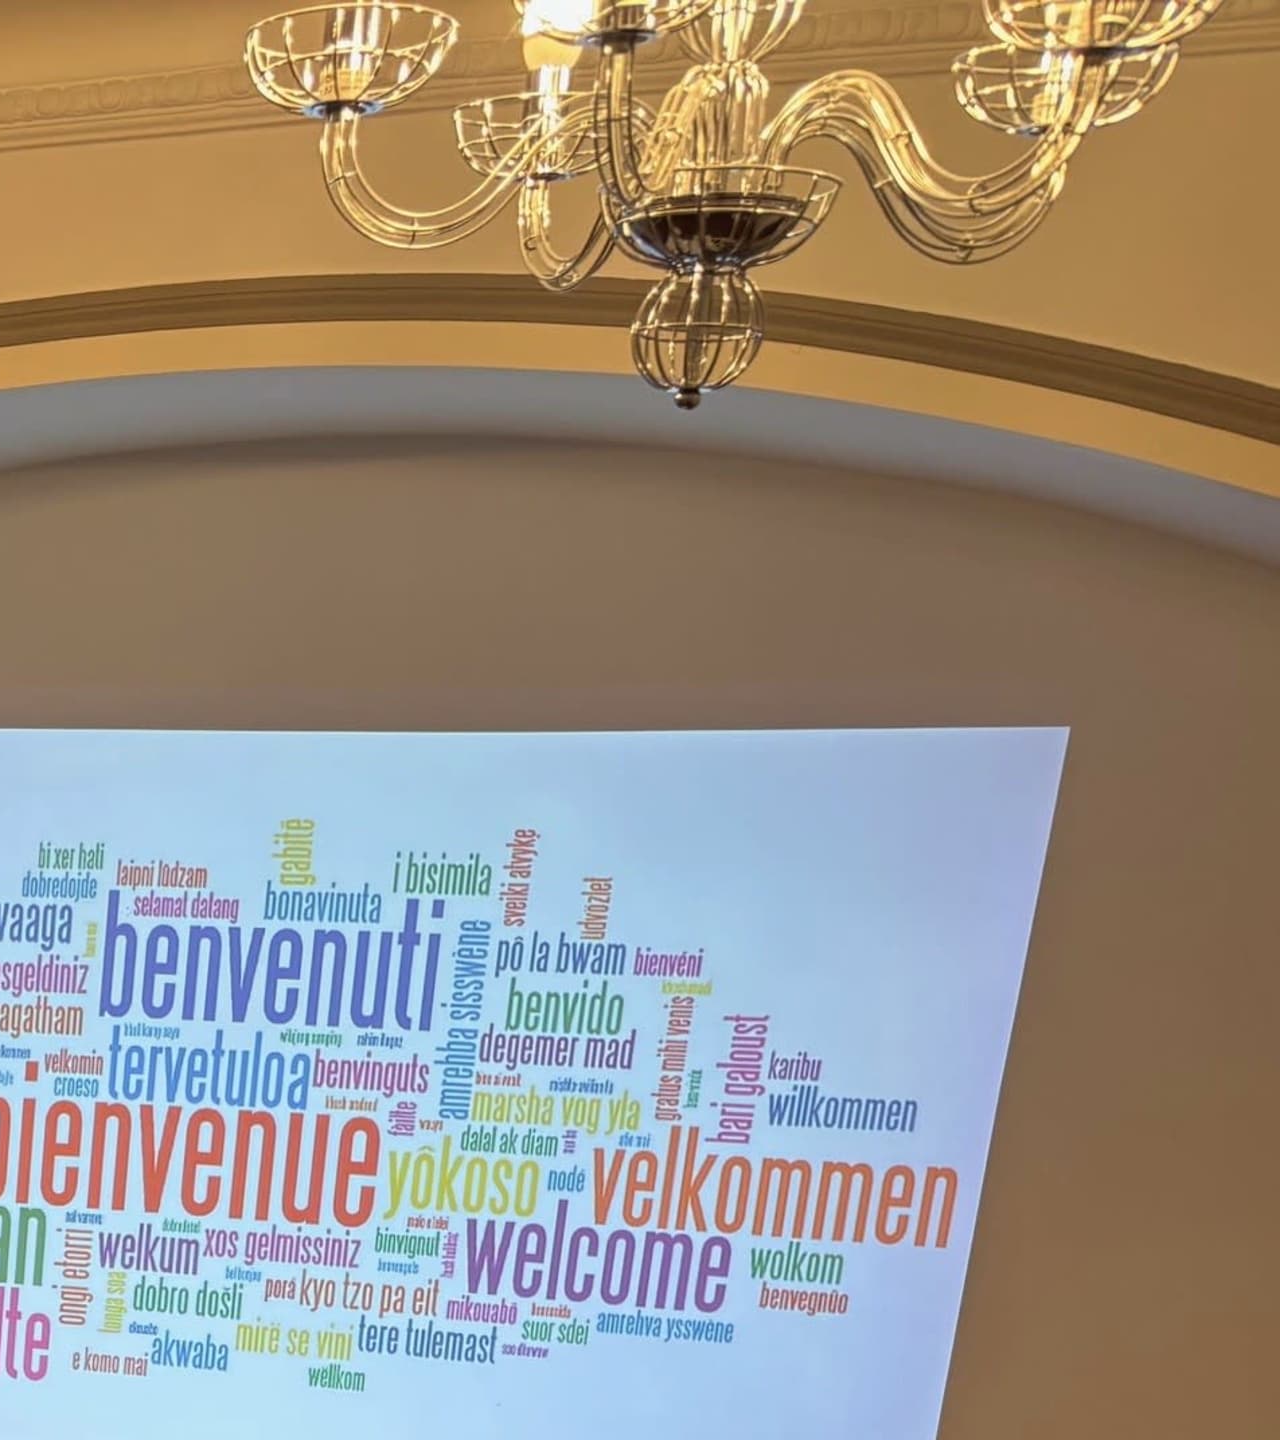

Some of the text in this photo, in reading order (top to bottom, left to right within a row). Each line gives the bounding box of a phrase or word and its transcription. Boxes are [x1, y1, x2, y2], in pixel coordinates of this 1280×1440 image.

[52, 847, 76, 870] xer
[116, 859, 156, 891] laipni
[392, 851, 491, 897] i bisimila
[22, 870, 97, 903] dobredojde
[263, 880, 382, 925] bonavinuta
[498, 882, 529, 928] sveiki
[99, 889, 445, 1032] benvenuti
[495, 931, 628, 978] pô la bwam
[632, 946, 704, 978] bienvéni
[505, 976, 625, 1036] benvido
[663, 995, 695, 1036] venis
[44, 1048, 104, 1076] velkomin
[108, 1024, 312, 1111] tervetuloa
[479, 1023, 637, 1071] degemer mad
[656, 1039, 689, 1072] mihi
[767, 1050, 823, 1082] karibu
[53, 1075, 100, 1099] croeso
[312, 1047, 430, 1098] benvinguts
[433, 1028, 479, 1121] amrehba
[705, 1013, 771, 1145] bari galoust
[471, 1085, 555, 1126] marsha
[562, 1095, 602, 1136] vog
[605, 1089, 642, 1136] yla
[651, 1074, 683, 1122] gratus
[768, 1084, 918, 1133] willkommen
[460, 1125, 495, 1153] dalal
[499, 1129, 518, 1154] ak
[521, 1130, 559, 1158] diam
[383, 1134, 540, 1220] yôkoso
[593, 1125, 958, 1249] velkommen
[54, 1227, 94, 1281] etorri
[97, 1222, 200, 1276] welkum
[202, 1227, 239, 1259] xos
[244, 1223, 362, 1268] gelmissiniz
[467, 1199, 732, 1314] welcome
[750, 1241, 845, 1286] wolkom
[51, 1284, 94, 1327] ongi
[132, 1275, 244, 1321] dobro došli
[299, 1269, 336, 1312] kyo
[342, 1273, 374, 1312] tzo
[378, 1282, 405, 1319] pa
[411, 1279, 440, 1318] eit
[235, 1316, 355, 1361] mirë se vini
[357, 1314, 498, 1365] tere tulemast
[521, 1317, 591, 1346] suor sdei
[596, 1309, 662, 1337] amrehva
[72, 1347, 150, 1377] e komo mai
[151, 1330, 229, 1372] akwaba
